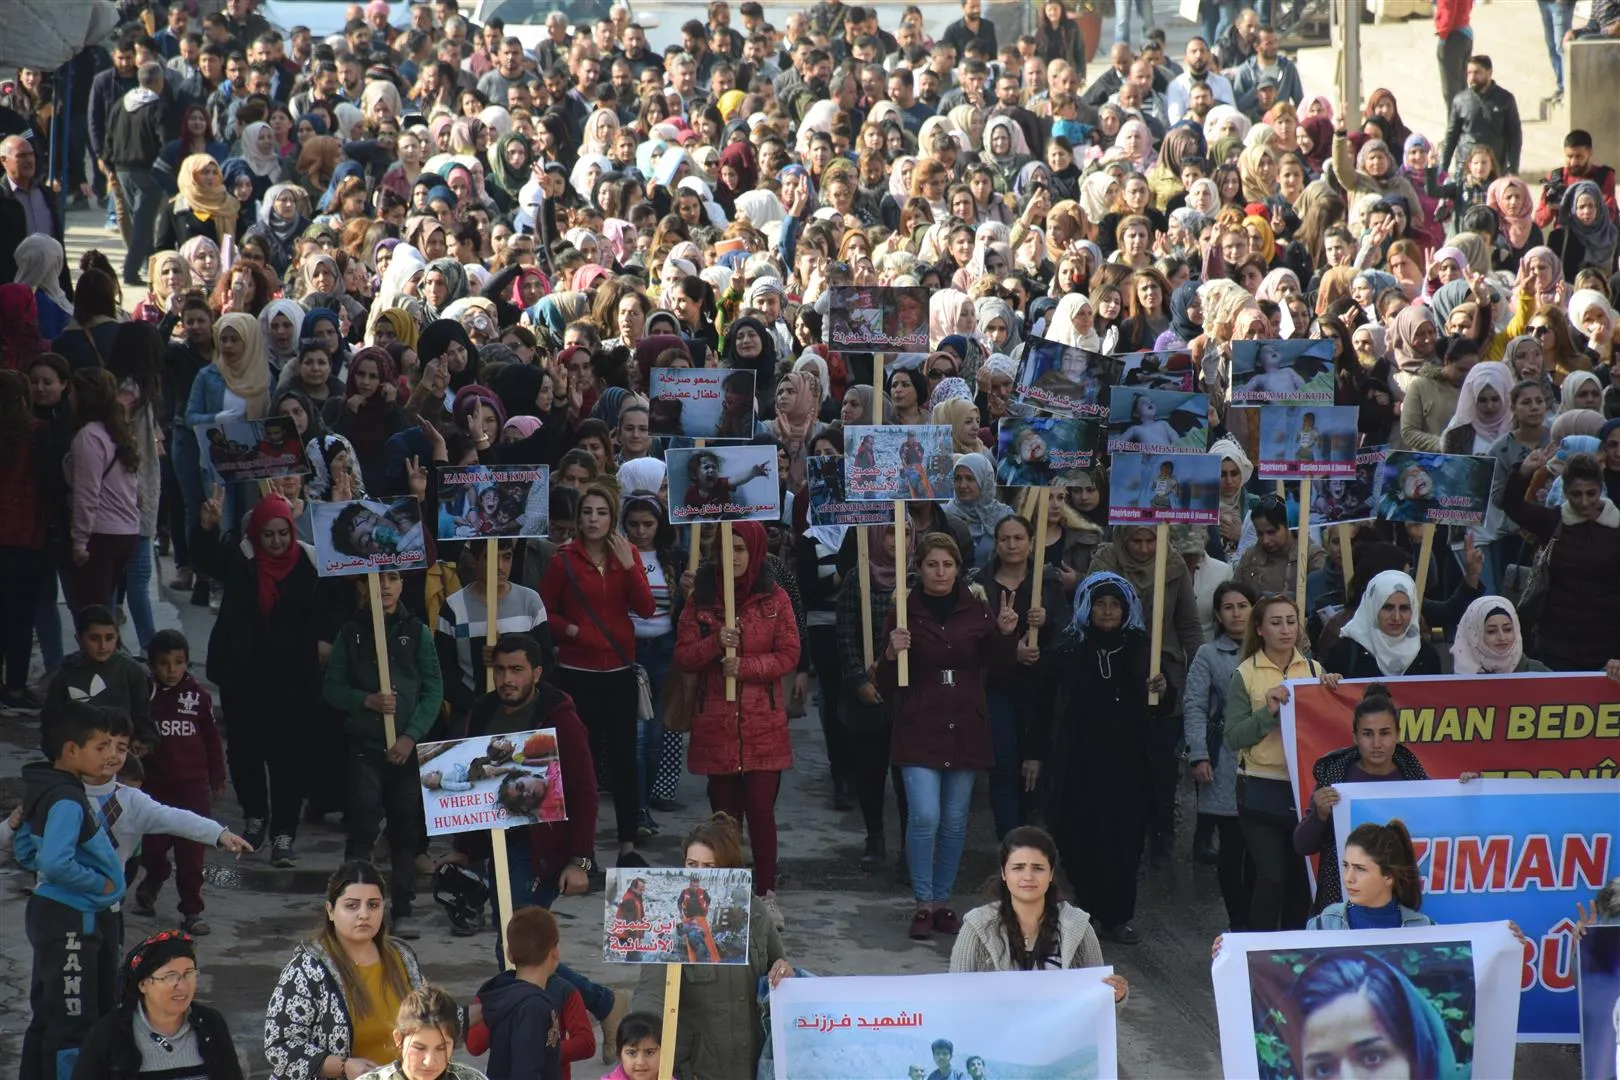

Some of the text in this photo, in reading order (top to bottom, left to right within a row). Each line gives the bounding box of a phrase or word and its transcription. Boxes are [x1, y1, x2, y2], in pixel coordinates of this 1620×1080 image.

[832, 332, 928, 346] لا للحرب ضد الطفولة
[660, 373, 720, 386] اسمعو صرخة
[659, 389, 721, 400] اطفال عفرين
[1071, 400, 1100, 415] للحرب
[1100, 406, 1110, 418] لا
[492, 471, 508, 483] NE
[509, 470, 543, 483] KUJIN
[850, 465, 897, 479] اين ضمير
[673, 503, 776, 517] اسمعو صرخات اطفال عفرين
[326, 558, 364, 572] عفرين
[367, 552, 397, 567] اطفال
[1399, 707, 1495, 742] MAN
[439, 792, 495, 809] WHERE IS
[434, 808, 507, 829] HUMANITY?
[609, 917, 676, 936] اين ضمير
[609, 937, 675, 957] الانسانية
[63, 931, 82, 1016] LAND
[797, 1011, 923, 1033] الشهيد فرزند
